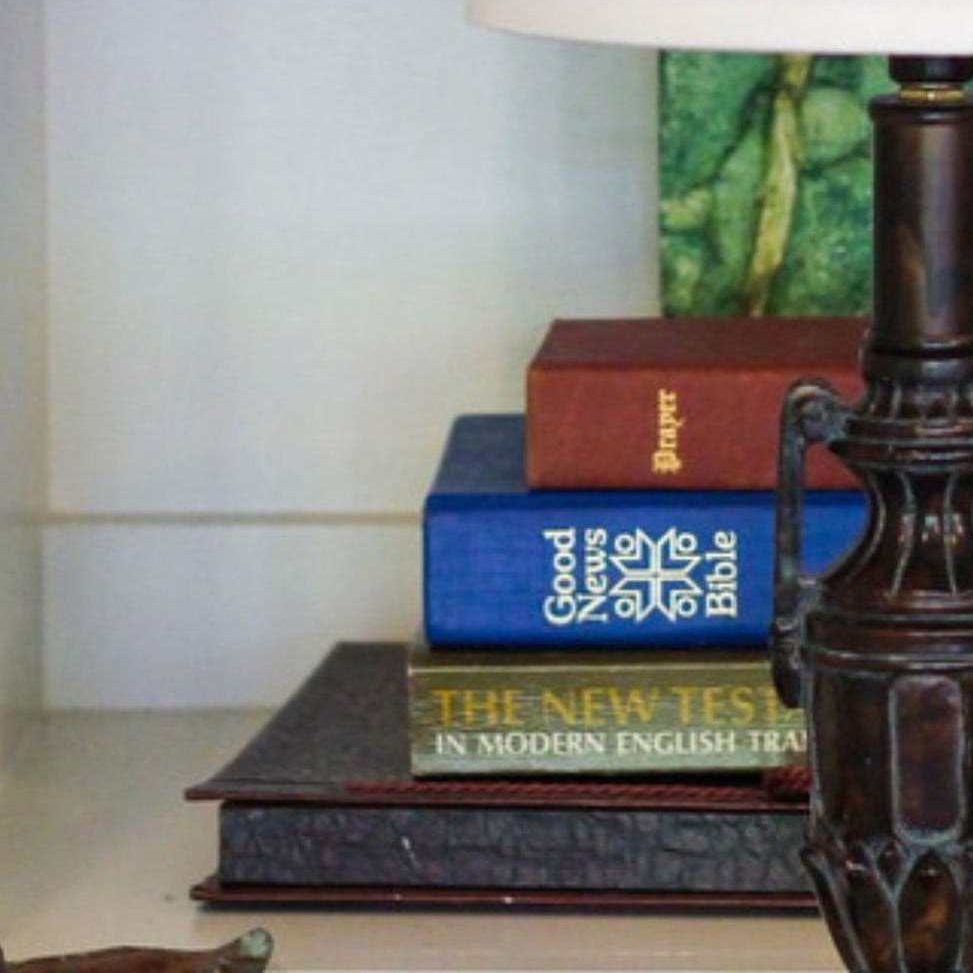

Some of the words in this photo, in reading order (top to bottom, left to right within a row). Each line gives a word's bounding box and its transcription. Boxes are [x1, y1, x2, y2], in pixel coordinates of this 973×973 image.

[543, 526, 576, 625] Good
[577, 527, 609, 623] News
[704, 530, 739, 619] Bible
[430, 687, 526, 727] THE
[540, 686, 660, 726] NEW
[435, 731, 466, 756] IN
[476, 730, 605, 756] MODERN
[617, 729, 735, 755] ENGLISH
